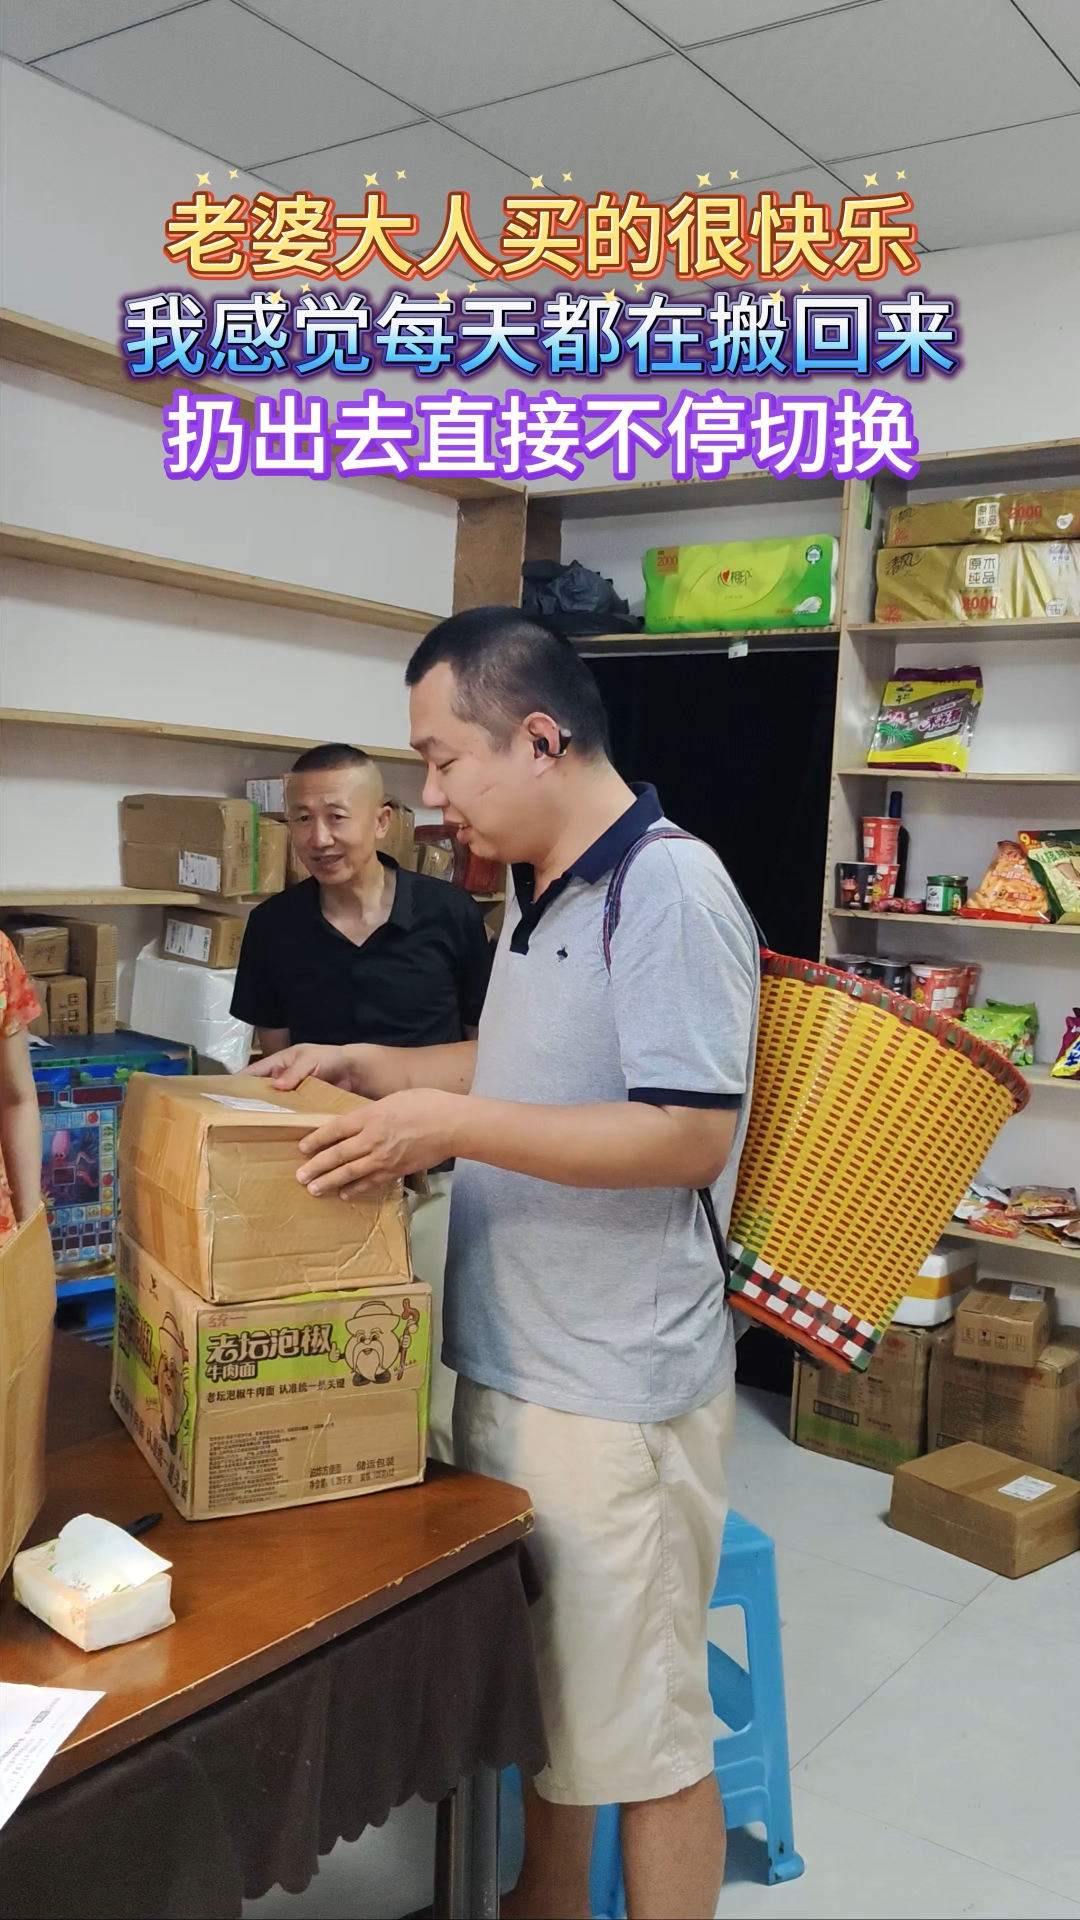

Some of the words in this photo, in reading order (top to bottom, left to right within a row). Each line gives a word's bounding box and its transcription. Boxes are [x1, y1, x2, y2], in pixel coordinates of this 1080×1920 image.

[657, 556, 678, 567] 2000
[969, 556, 996, 571] 原木
[968, 571, 996, 585] 纯品
[208, 1314, 247, 1328] 统一
[206, 1324, 333, 1364] 老坛泡椒
[206, 1362, 257, 1382] 牛肉面
[207, 1385, 275, 1402] 老坛泡椒牛肉面
